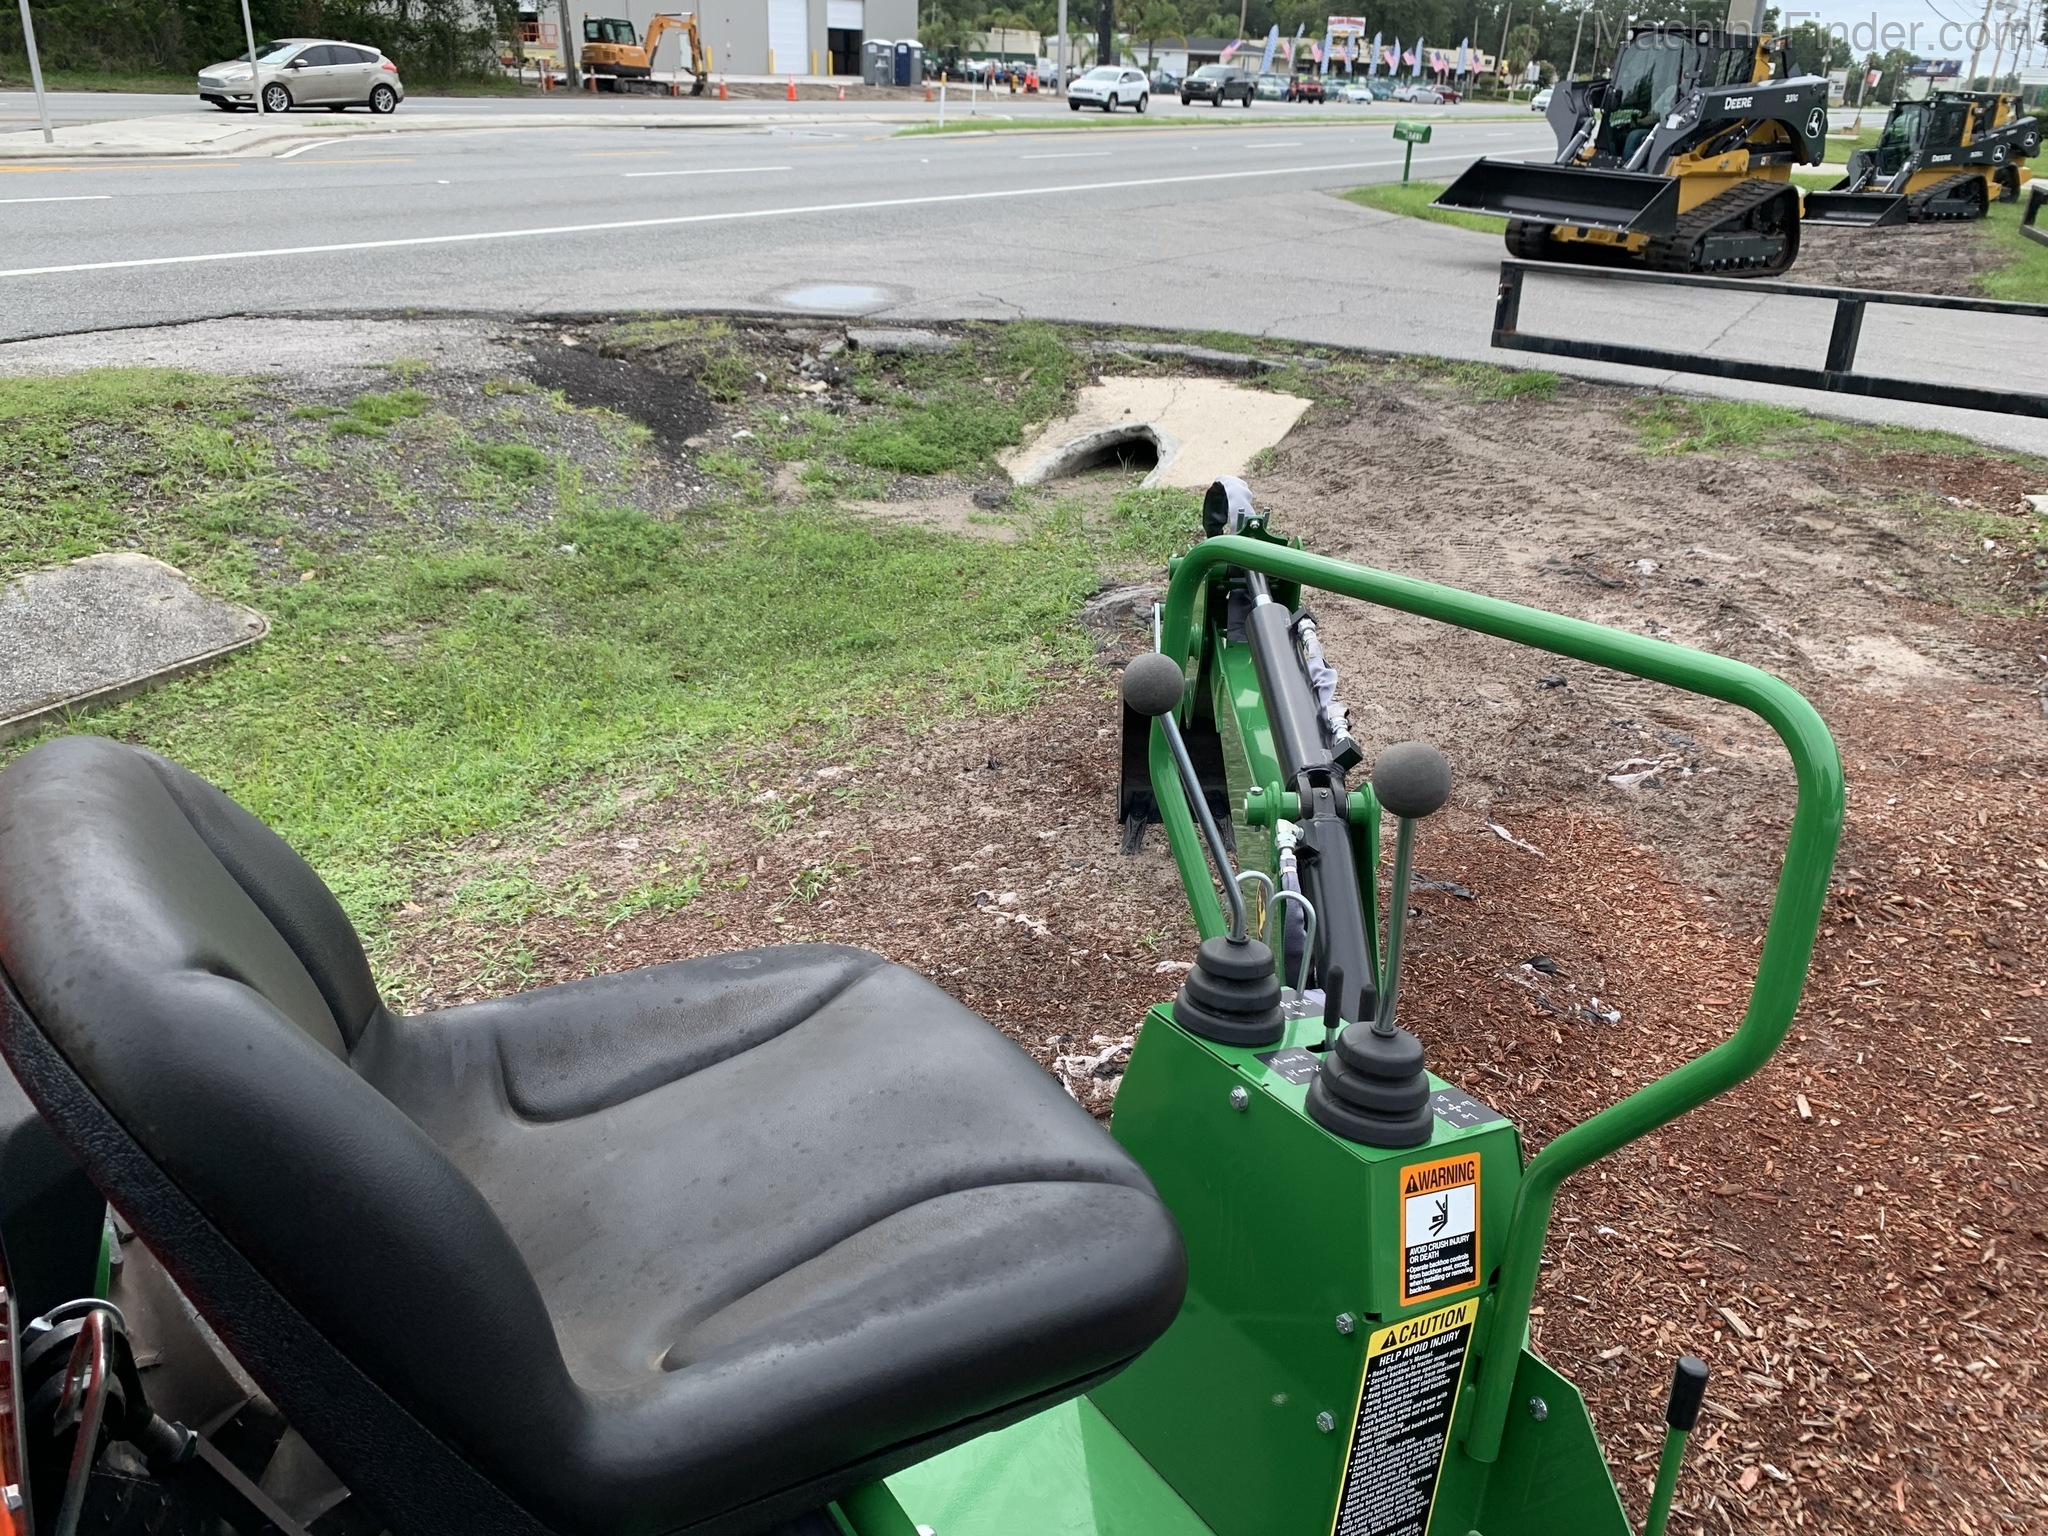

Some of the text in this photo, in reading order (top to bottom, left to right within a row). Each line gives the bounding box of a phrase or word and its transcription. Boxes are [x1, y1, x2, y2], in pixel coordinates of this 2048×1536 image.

[1724, 97, 1753, 110] DEERE
[1418, 1161, 1475, 1190] WARNING
[1410, 1235, 1469, 1256] AVOID CRUSH INJURY
[1410, 1251, 1439, 1264] OR DEATH
[1410, 1253, 1469, 1273] Operate backhoe controls
[1422, 1267, 1442, 1278] backhoe
[1454, 1260, 1470, 1269] except
[1424, 1273, 1445, 1284] installing
[1452, 1266, 1473, 1276] removing
[1409, 1284, 1431, 1294] backhoe.
[1399, 1306, 1467, 1343] CAUTION
[1379, 1329, 1460, 1367] HELP AVOID INJURY
[1370, 1374, 1389, 1385] Secure
[1389, 1366, 1410, 1378] backhoe
[1416, 1358, 1433, 1368] tractor
[1433, 1352, 1449, 1362] mount
[1449, 1347, 1464, 1357] plates
[1372, 1367, 1386, 1378] Read
[1367, 1361, 1460, 1400] Keep bystanders away from maximum
[1369, 1384, 1380, 1392] with
[1381, 1379, 1392, 1388] lock
[1392, 1375, 1404, 1385] pins
[1405, 1369, 1422, 1379] before
[1366, 1397, 1382, 1409] swing
[1382, 1391, 1397, 1401] reach
[1397, 1387, 1409, 1395] area
[1410, 1382, 1420, 1391] and
[1373, 1403, 1382, 1411] not
[1382, 1396, 1402, 1408] operate
[1402, 1390, 1420, 1400] tractor
[1420, 1385, 1430, 1394] and
[1430, 1378, 1450, 1390] backhoe
[1362, 1391, 1448, 1429] Lock backhoe swing and boom with
[1363, 1412, 1378, 1422] using
[1357, 1412, 1444, 1451] Lower stabilizers and bucket before
[1360, 1425, 1379, 1436] locking
[1379, 1418, 1397, 1429] device
[1397, 1413, 1411, 1422] when
[1411, 1408, 1420, 1416] not
[1358, 1434, 1373, 1443] when
